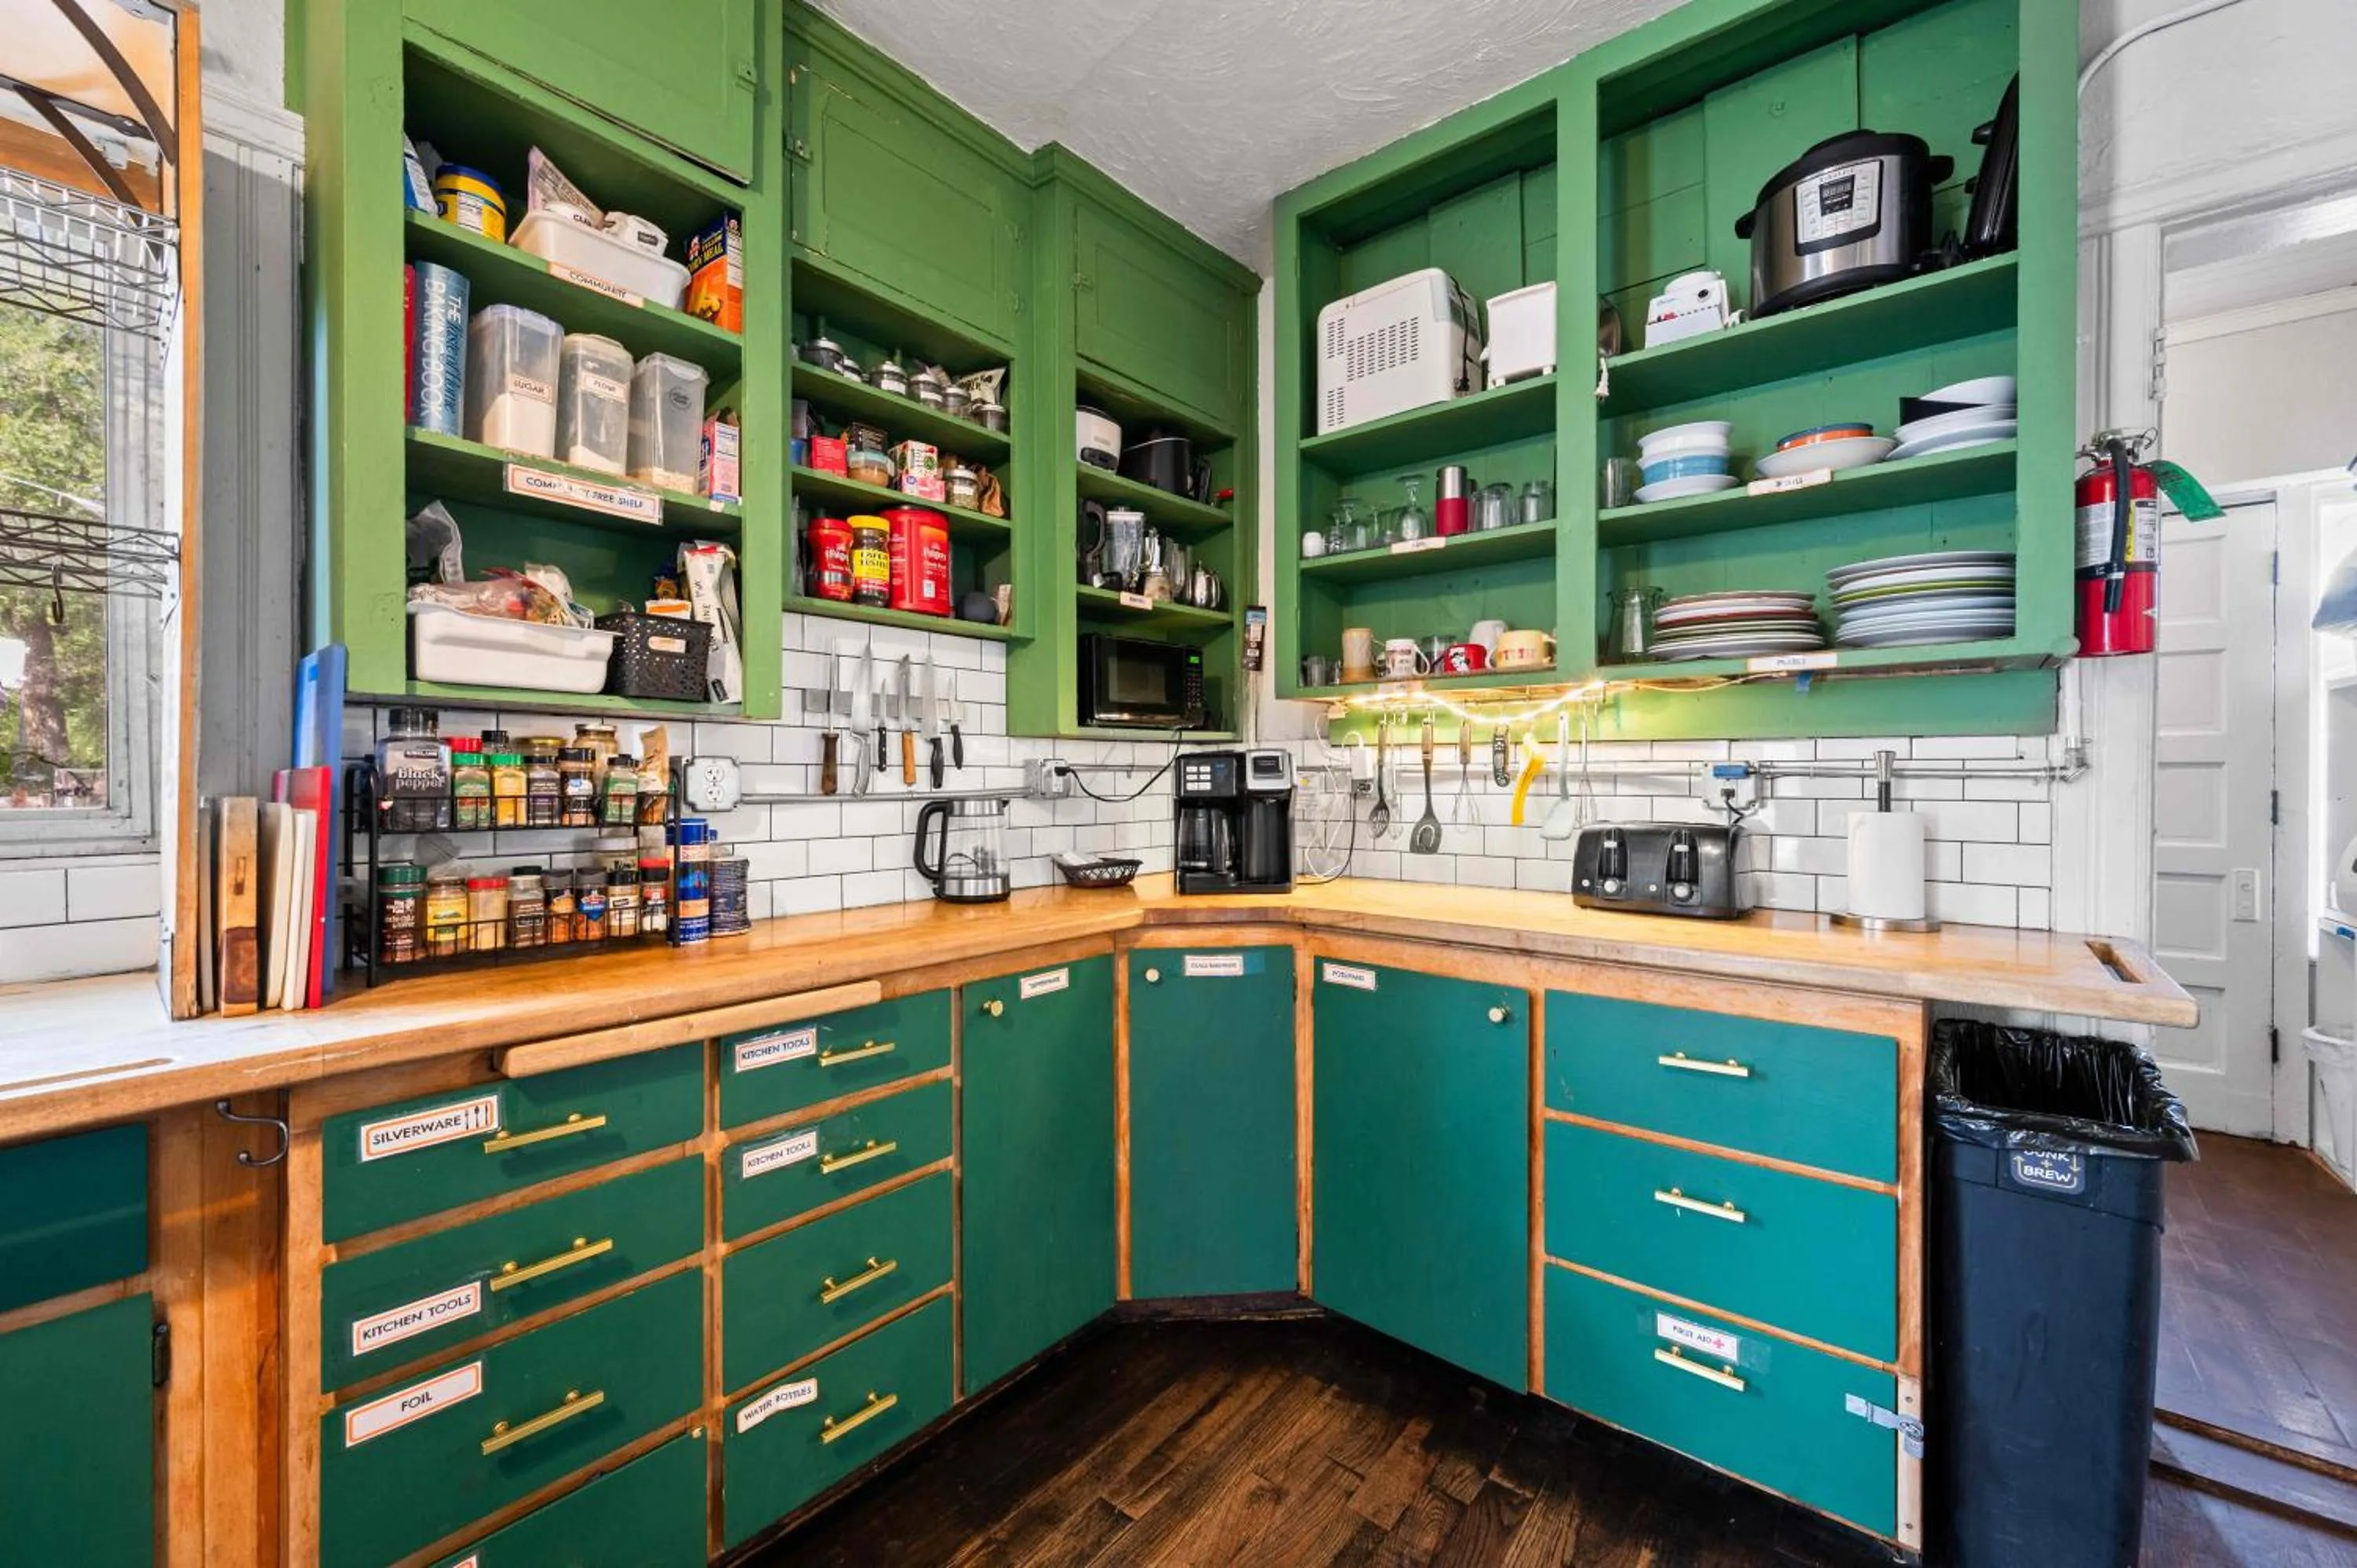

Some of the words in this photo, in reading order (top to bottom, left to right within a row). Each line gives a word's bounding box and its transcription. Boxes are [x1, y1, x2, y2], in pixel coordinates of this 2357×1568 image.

[423, 278, 446, 354] BAKING
[448, 296, 462, 324] THE
[420, 357, 444, 420] BOOK
[515, 379, 544, 394] SUGAR
[592, 491, 614, 504] FREE
[618, 497, 644, 508] SHELF
[396, 778, 445, 789] pepper
[398, 768, 439, 779] black
[742, 1044, 780, 1059] KITCHEN
[783, 1037, 810, 1050] TOOLS
[372, 1115, 462, 1145] SILVERWARE
[748, 1150, 783, 1168] KITCHEN
[786, 1141, 811, 1156] TOOLS
[2024, 1165, 2071, 1182] BREW
[363, 1310, 423, 1341] KITCHEN
[427, 1294, 471, 1317] TOOLS
[1673, 1325, 1693, 1339] FIRST
[1697, 1334, 1712, 1343] AID
[401, 1391, 433, 1412] FOIL
[745, 1400, 772, 1420] WATER
[775, 1386, 812, 1402] BOTTLES
